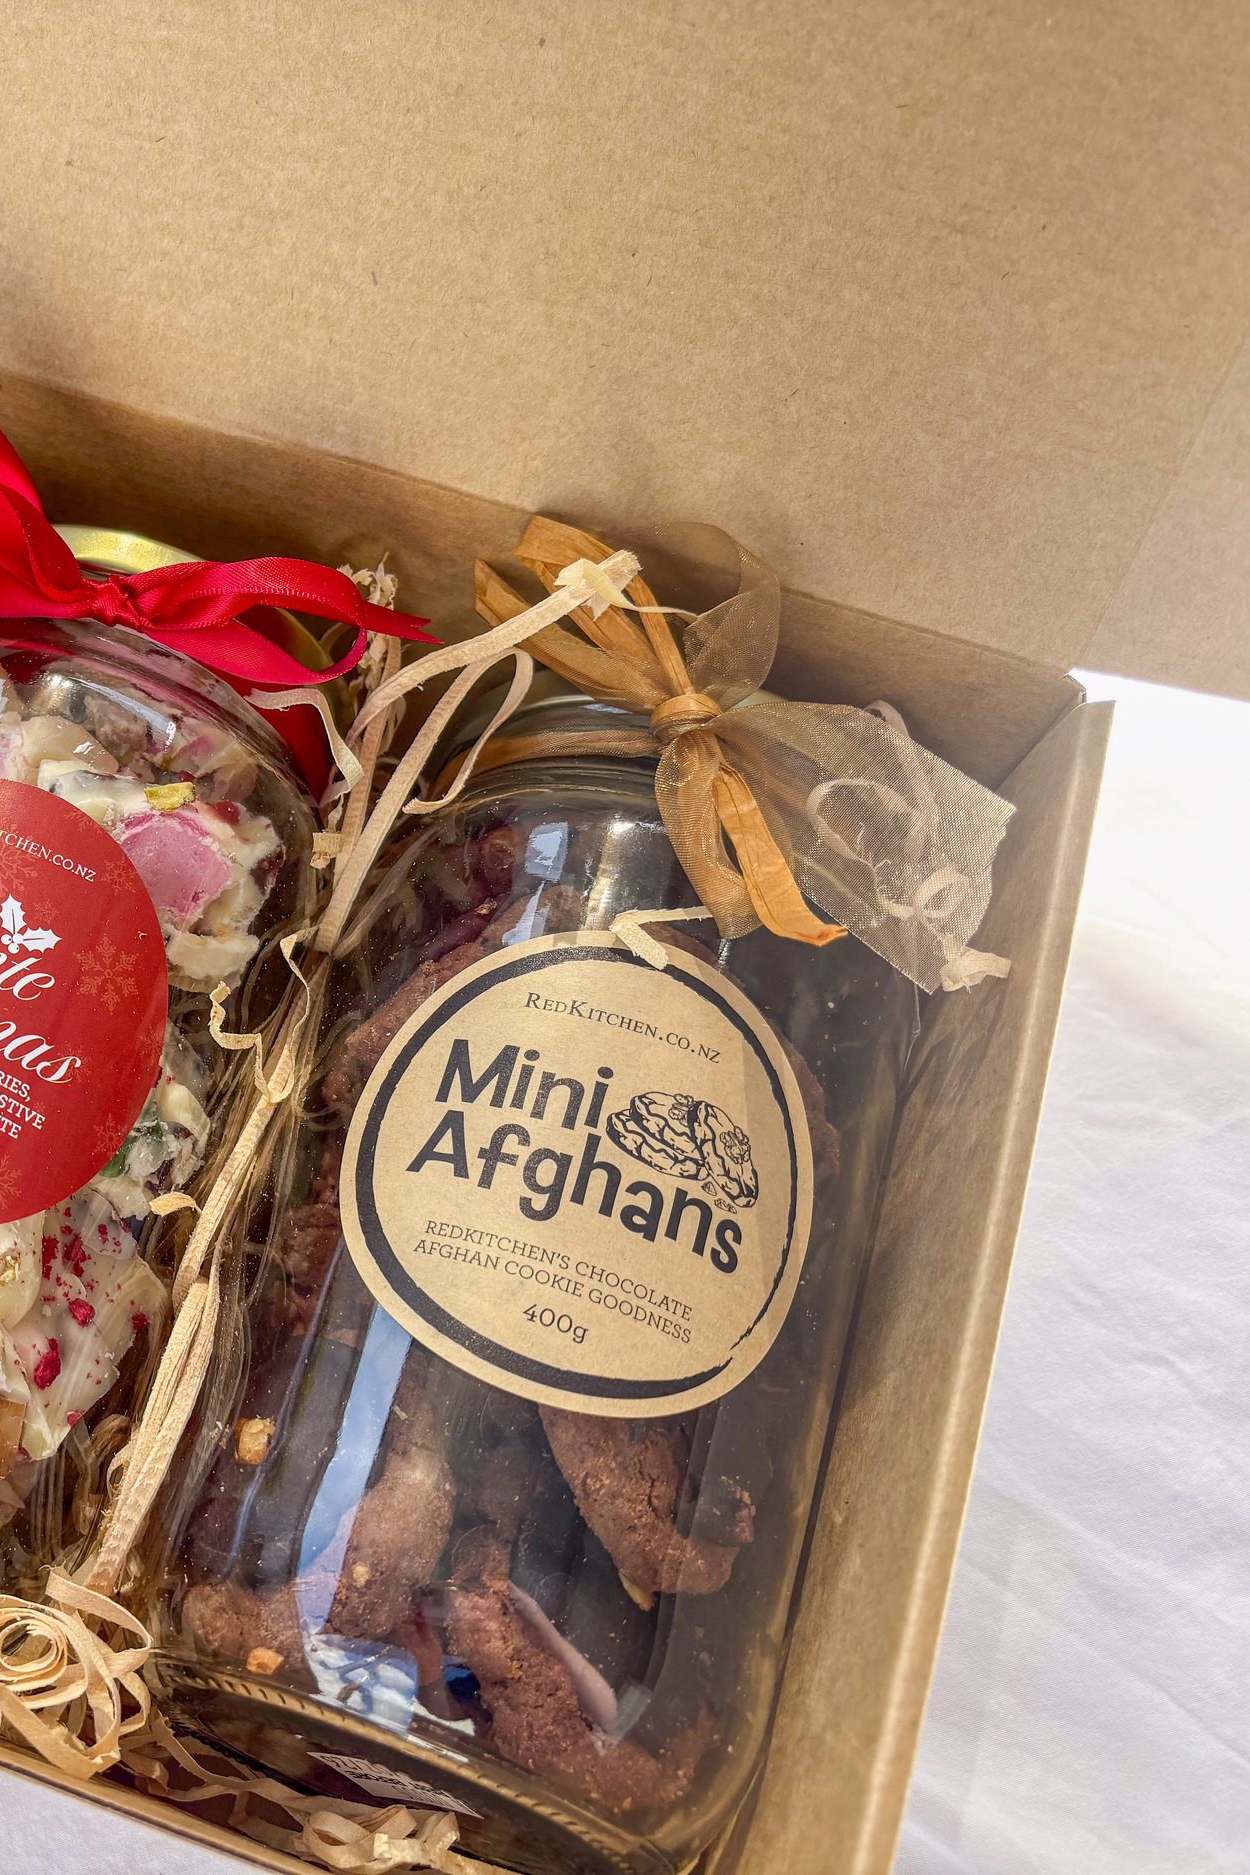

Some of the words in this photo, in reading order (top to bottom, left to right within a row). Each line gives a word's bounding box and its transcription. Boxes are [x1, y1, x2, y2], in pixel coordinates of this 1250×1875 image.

[435, 1038, 614, 1130] Mini
[406, 1109, 743, 1274] Afghans
[413, 1239, 500, 1270] AFGHAN
[504, 1260, 585, 1298] COOKIE
[588, 1288, 691, 1344] GOODNESS
[425, 1220, 570, 1270] REDKITCHEN'S
[575, 1261, 693, 1322] CHOCOLATE
[522, 1304, 588, 1344] 400g
